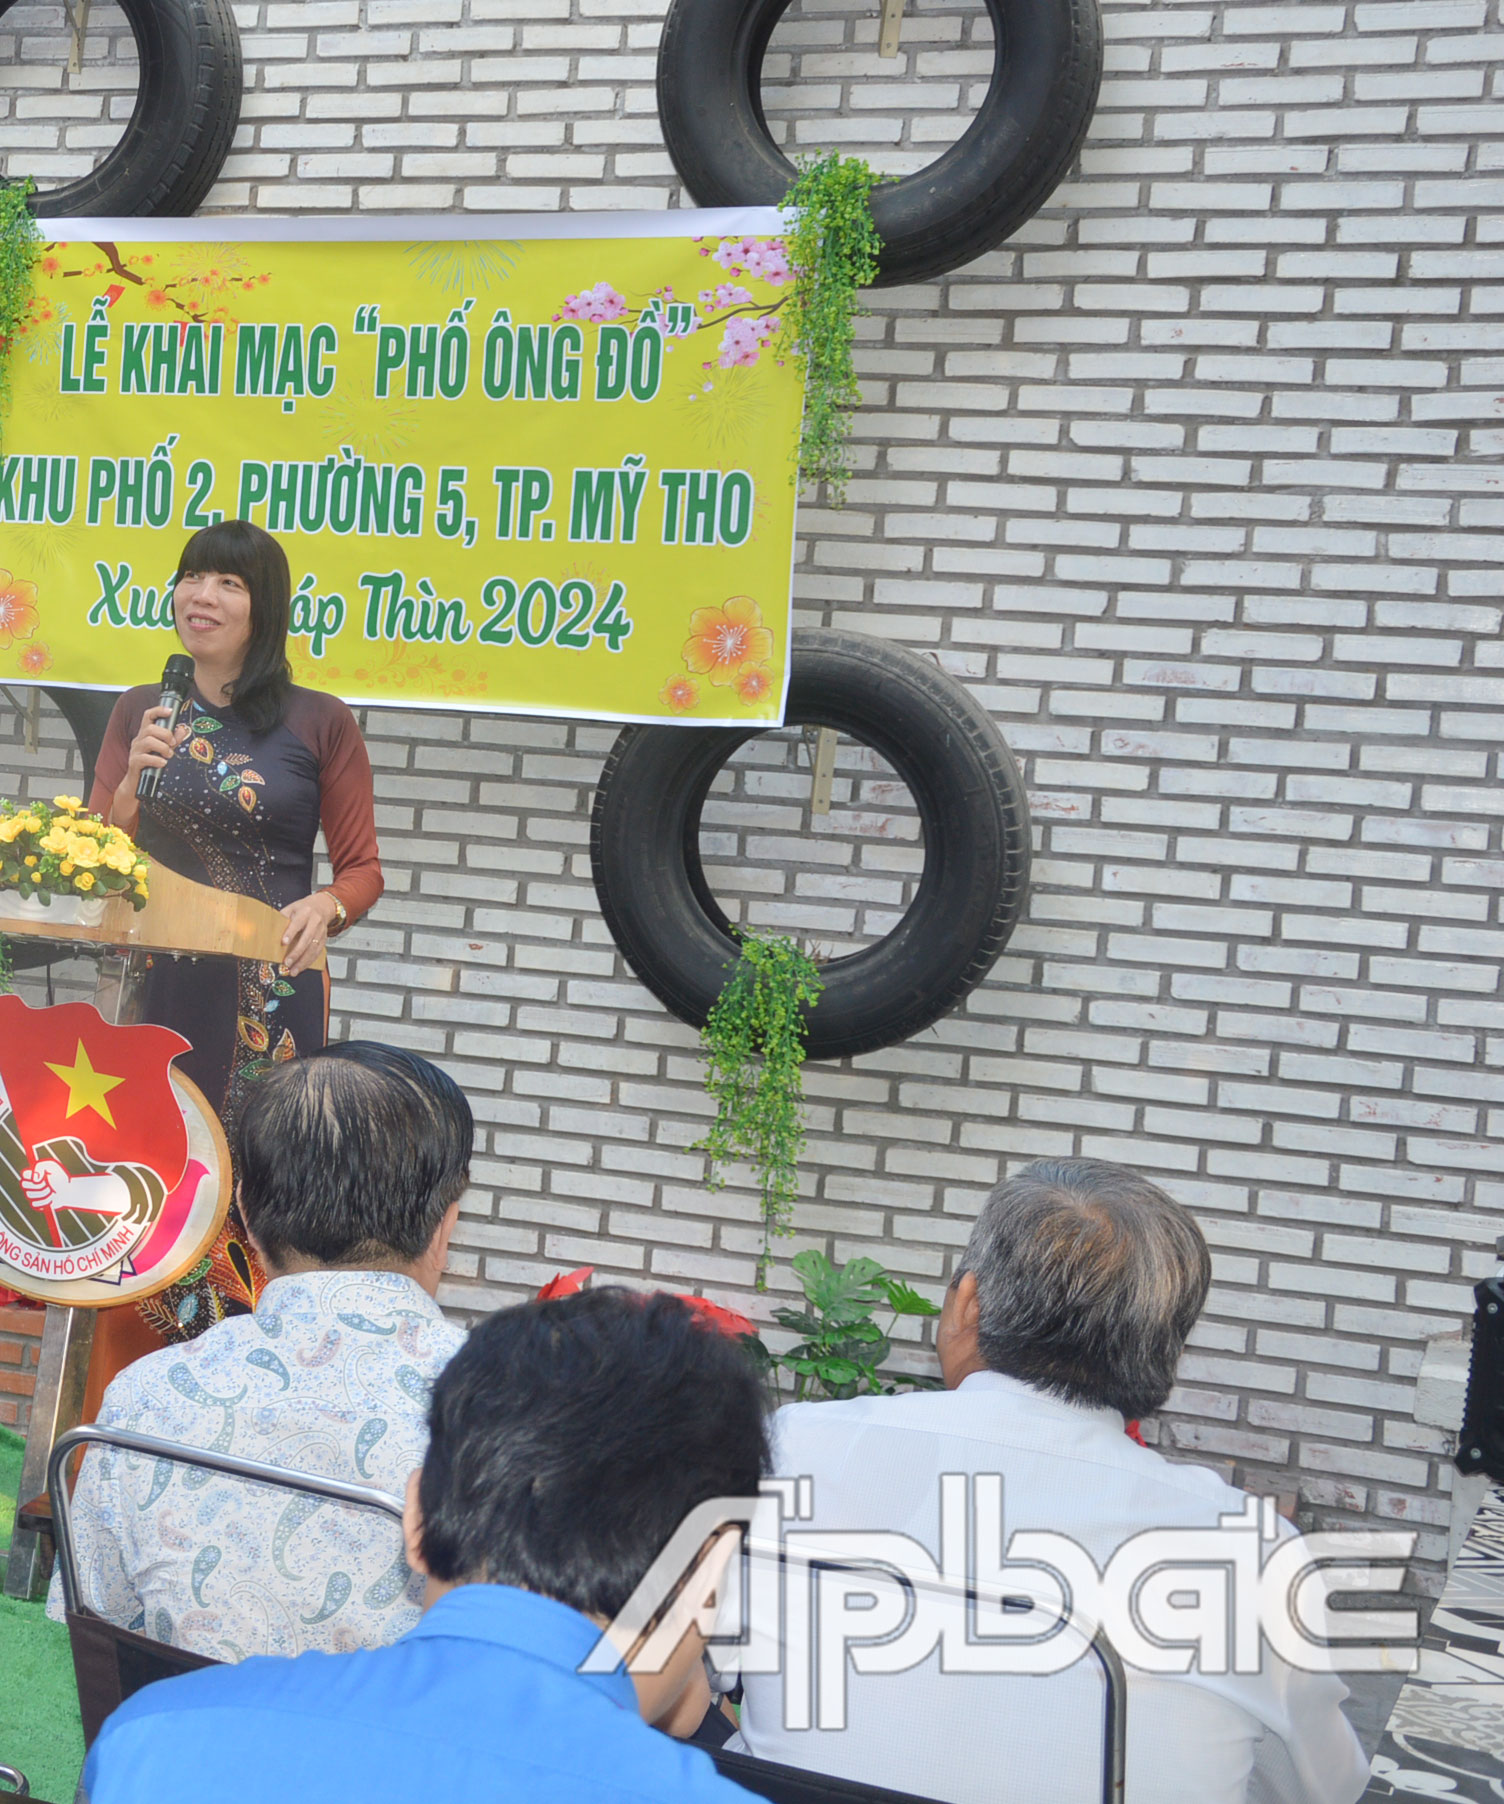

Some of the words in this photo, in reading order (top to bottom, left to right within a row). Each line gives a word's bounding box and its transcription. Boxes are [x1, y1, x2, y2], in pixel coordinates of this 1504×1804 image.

[60, 296, 110, 393] LỄ
[120, 322, 224, 395] KHAI
[234, 323, 338, 413] MẠC
[483, 308, 583, 401] ÔNG
[86, 434, 180, 528] PHỐ
[237, 445, 425, 537] PHƯỜNG
[435, 465, 478, 548] 5,
[493, 466, 555, 542] TP.
[568, 453, 649, 544] MỸ
[660, 469, 754, 547] THO
[288, 573, 346, 659] áp
[359, 570, 473, 643] Thìn
[478, 576, 632, 653] 2024
[21, 1251, 51, 1275] SẢN
[53, 1255, 75, 1275] HỒ
[77, 1247, 103, 1272] CHÍ
[100, 1225, 135, 1261] MINH
